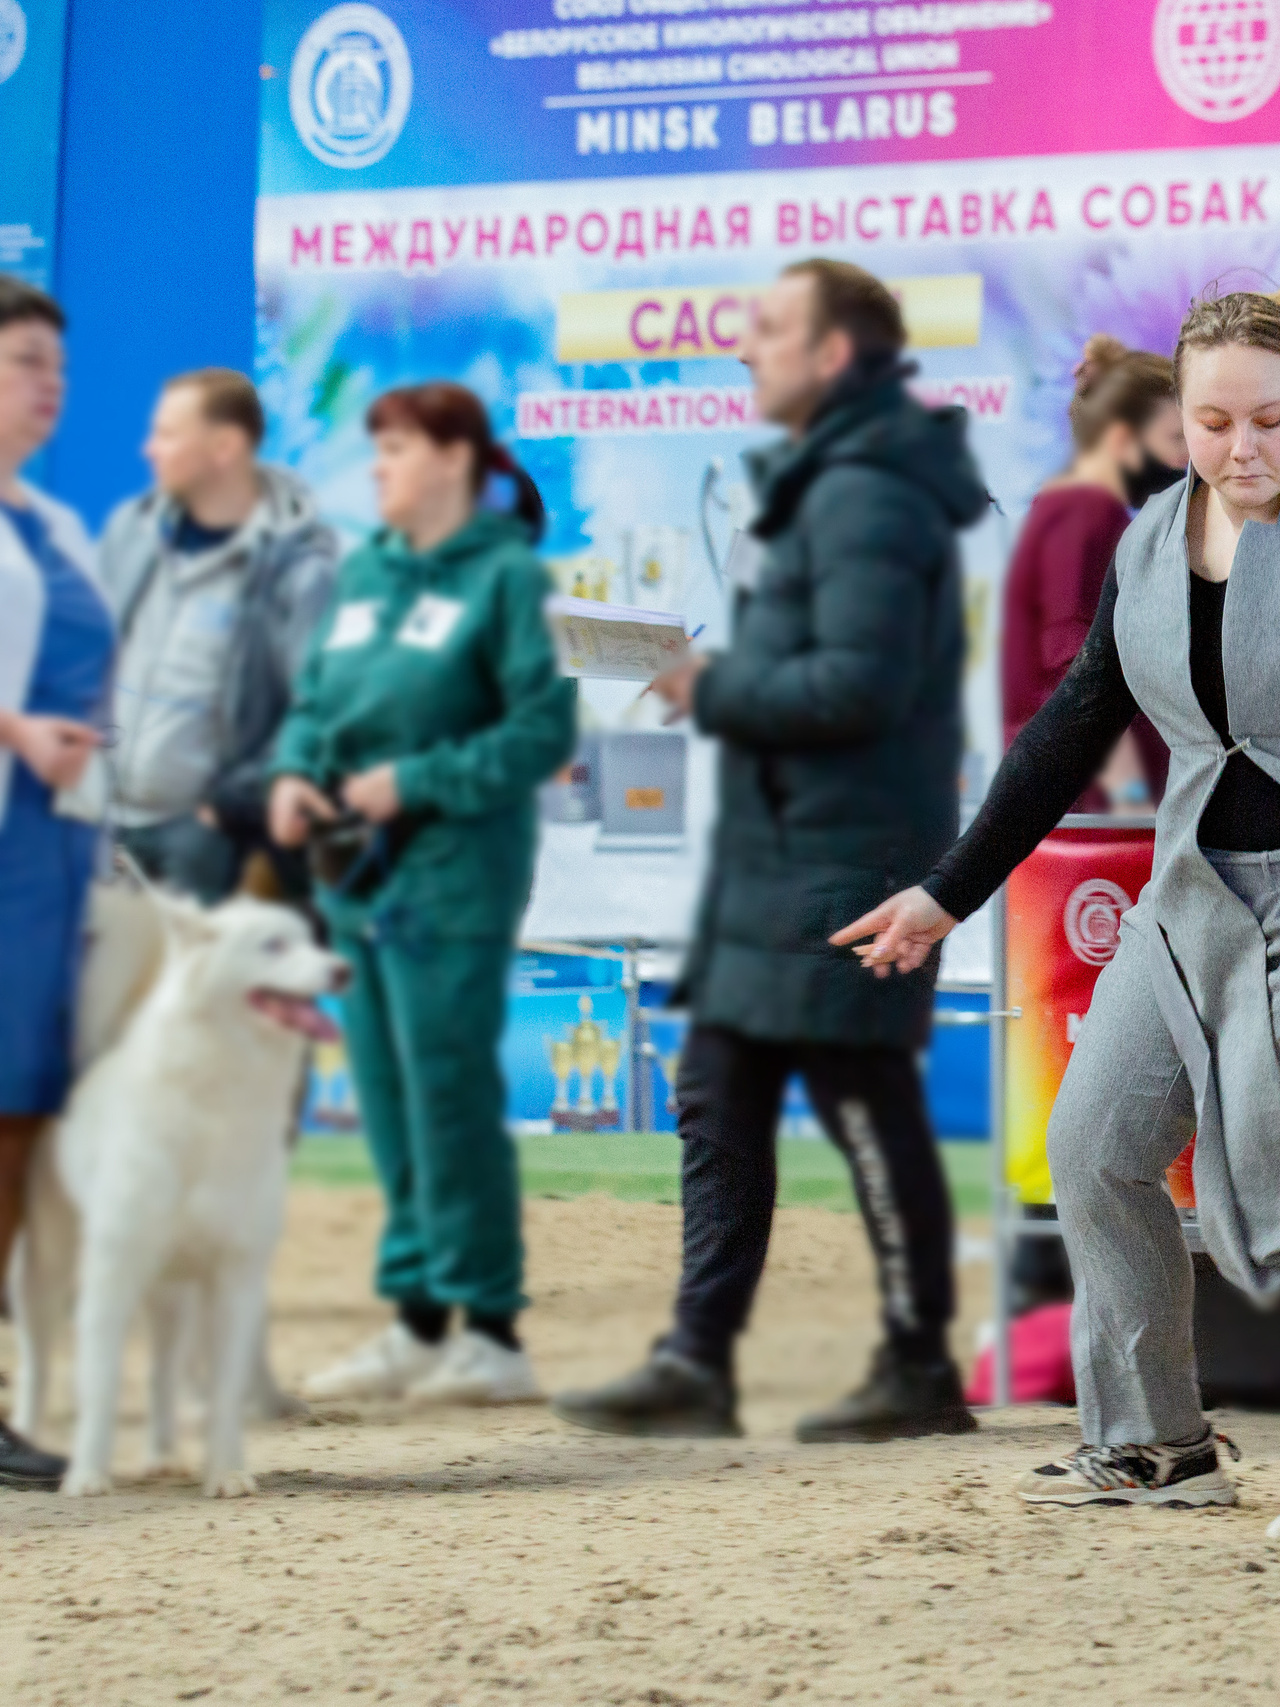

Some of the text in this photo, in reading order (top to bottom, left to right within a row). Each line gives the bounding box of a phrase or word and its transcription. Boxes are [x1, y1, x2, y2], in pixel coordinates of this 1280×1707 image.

[576, 90, 956, 156] MINSK BELARUS
[289, 177, 1270, 271] МЕЖДУНАРОДНАЯ ВЫСТАВКА СОБАК
[629, 297, 757, 352] CAC
[521, 391, 757, 432] INTERNATION
